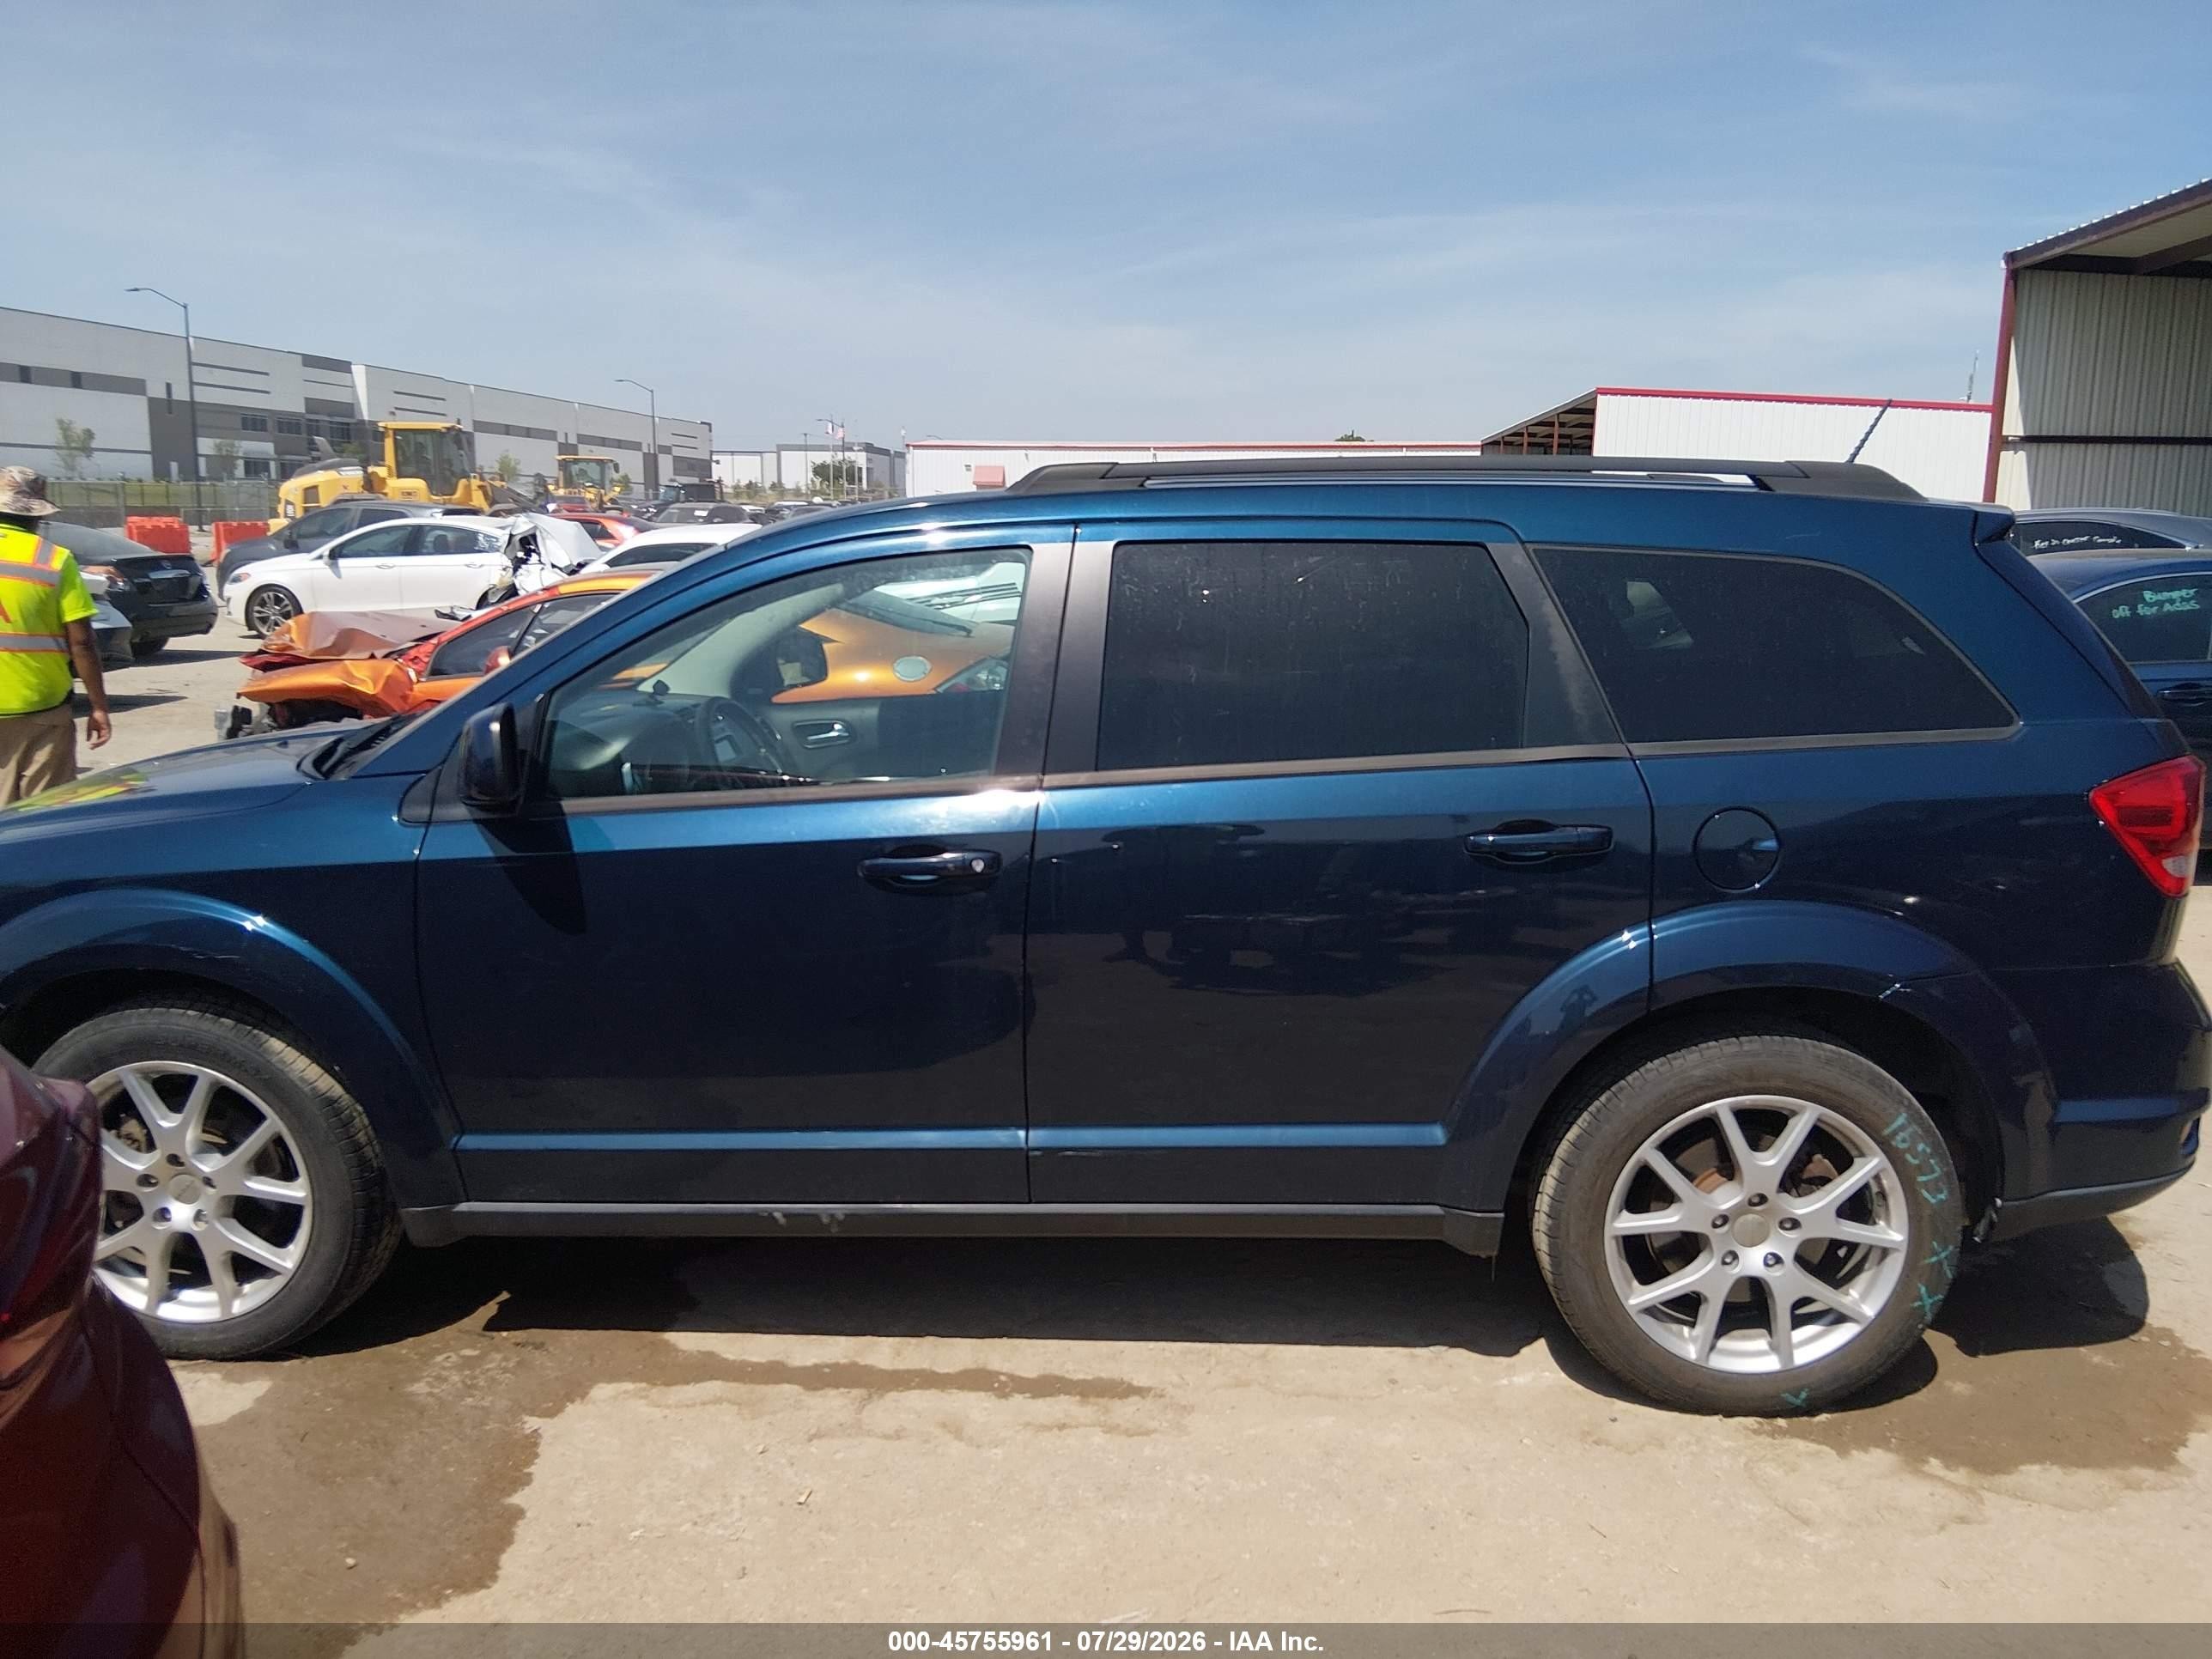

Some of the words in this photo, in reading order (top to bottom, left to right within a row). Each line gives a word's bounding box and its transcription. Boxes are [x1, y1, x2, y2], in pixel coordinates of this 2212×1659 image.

[2142, 588, 2198, 603] Bumper
[2112, 605, 2131, 618] off
[2136, 604, 2159, 616] for
